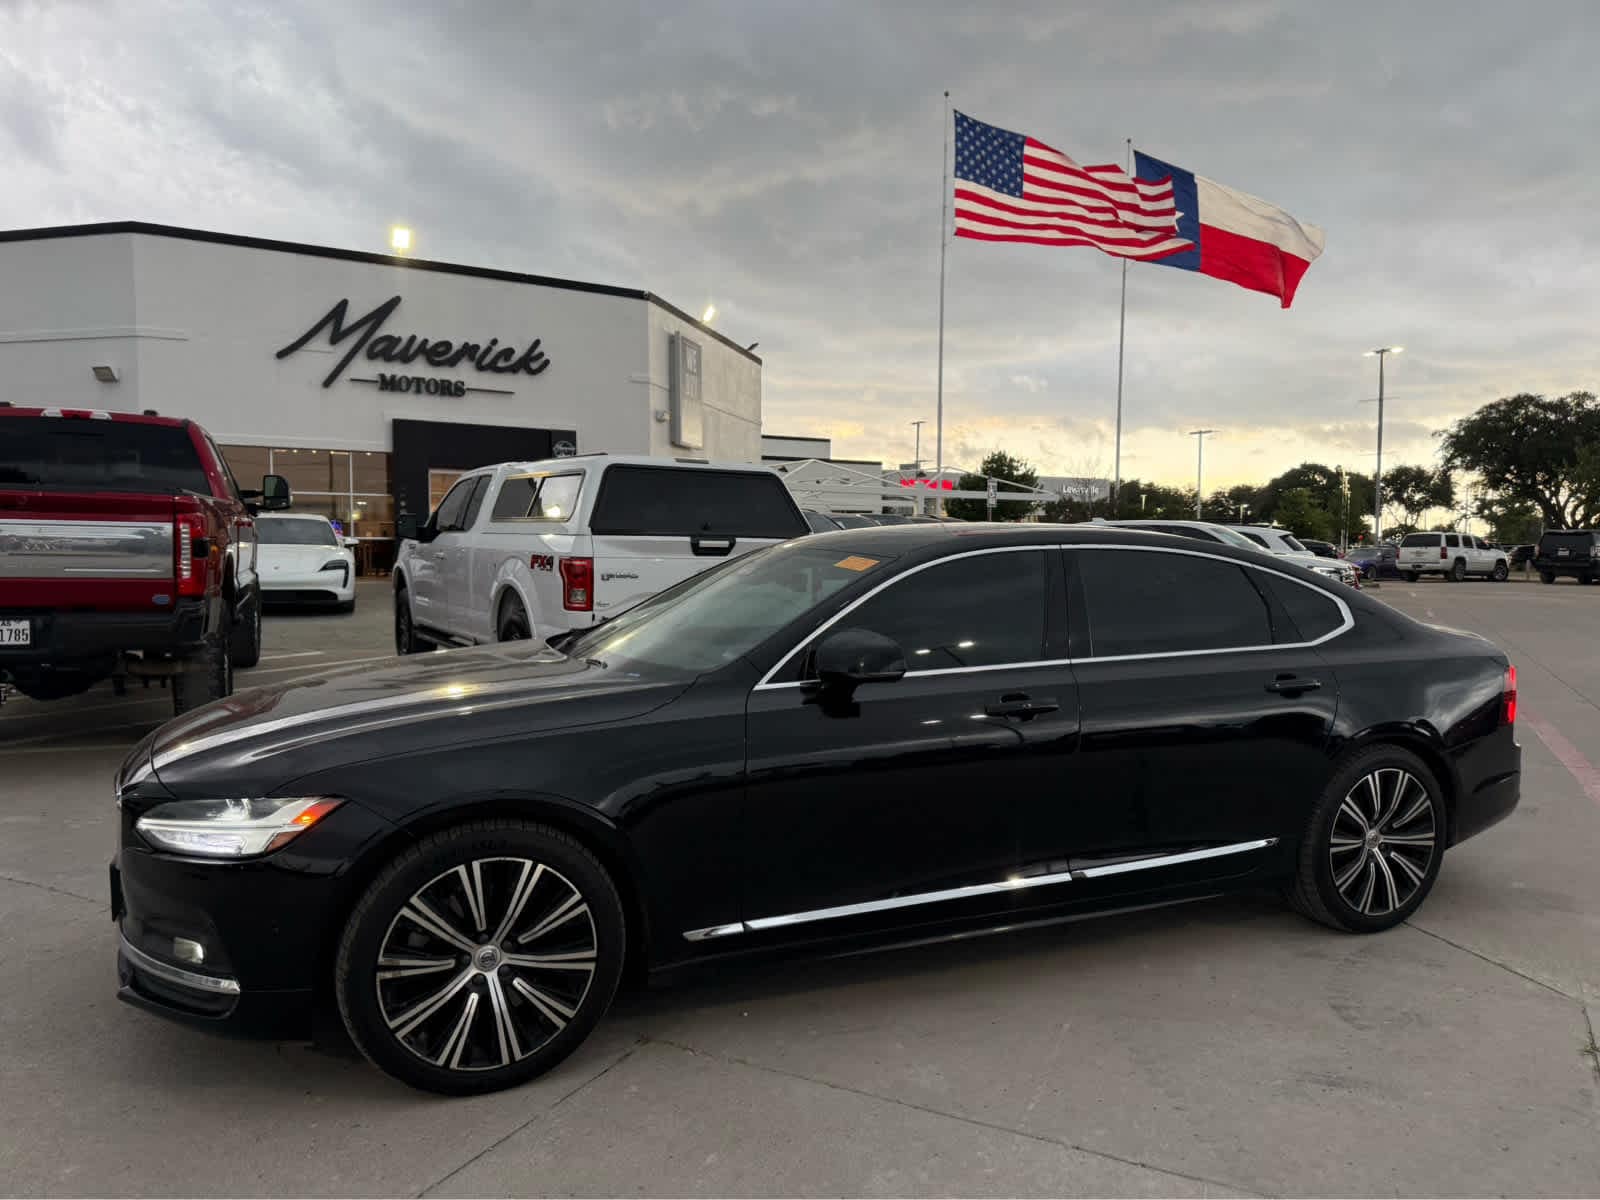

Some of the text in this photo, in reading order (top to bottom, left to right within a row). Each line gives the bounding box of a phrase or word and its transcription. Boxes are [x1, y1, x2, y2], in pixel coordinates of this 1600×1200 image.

[276, 296, 550, 388] Maverick
[378, 374, 466, 397] MOTORS
[530, 554, 554, 571] FX4
